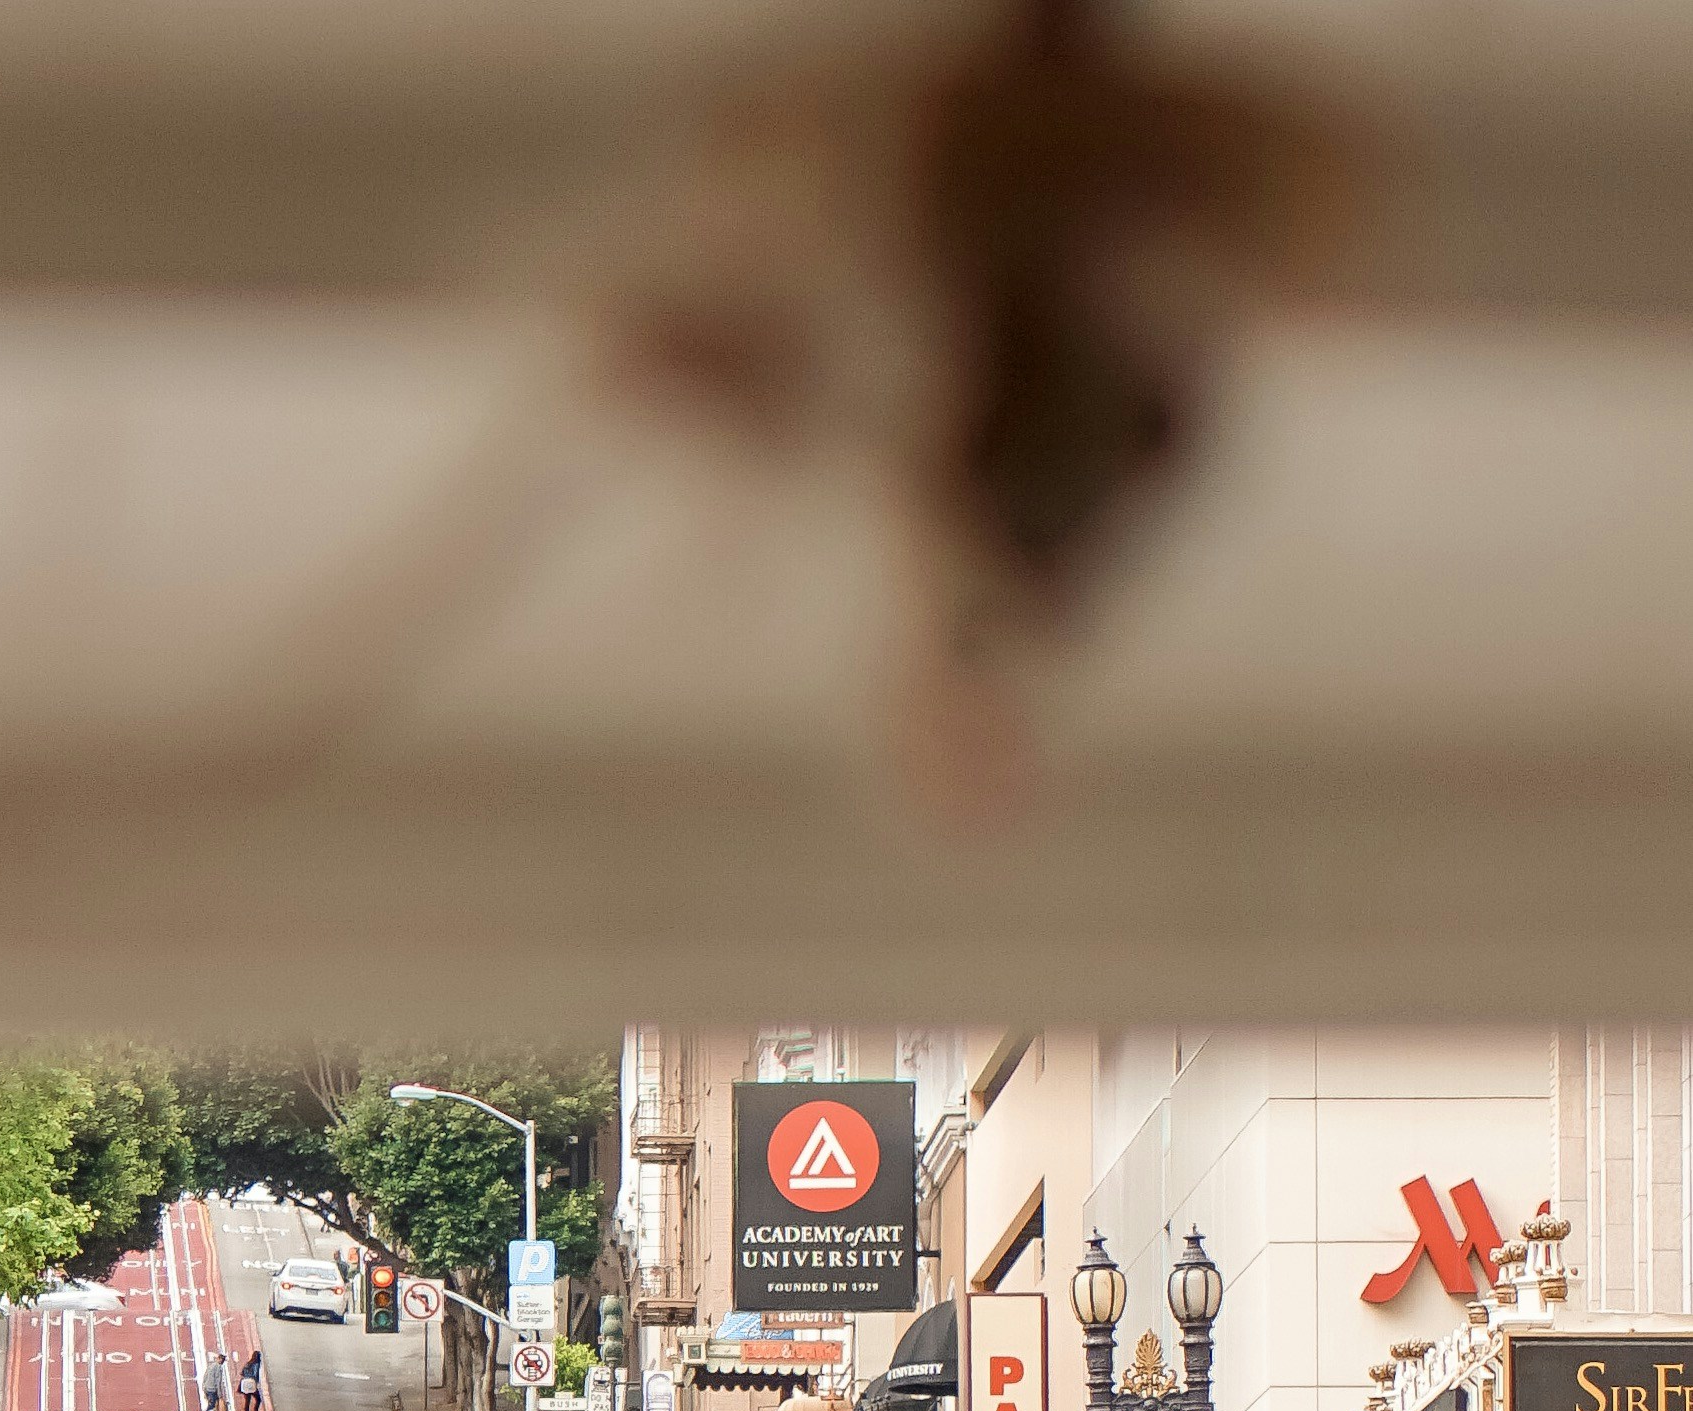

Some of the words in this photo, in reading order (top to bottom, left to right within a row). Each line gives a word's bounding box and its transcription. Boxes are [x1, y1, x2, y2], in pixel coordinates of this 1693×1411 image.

[742, 1226, 845, 1243] ACADEMY
[844, 1227, 864, 1247] of
[862, 1226, 904, 1243] ART
[742, 1250, 904, 1268] UNIVERSITY
[767, 1282, 829, 1293] FOUNDED
[832, 1282, 848, 1292] IN
[852, 1282, 879, 1292] 1929
[549, 1400, 578, 1408] BUSH
